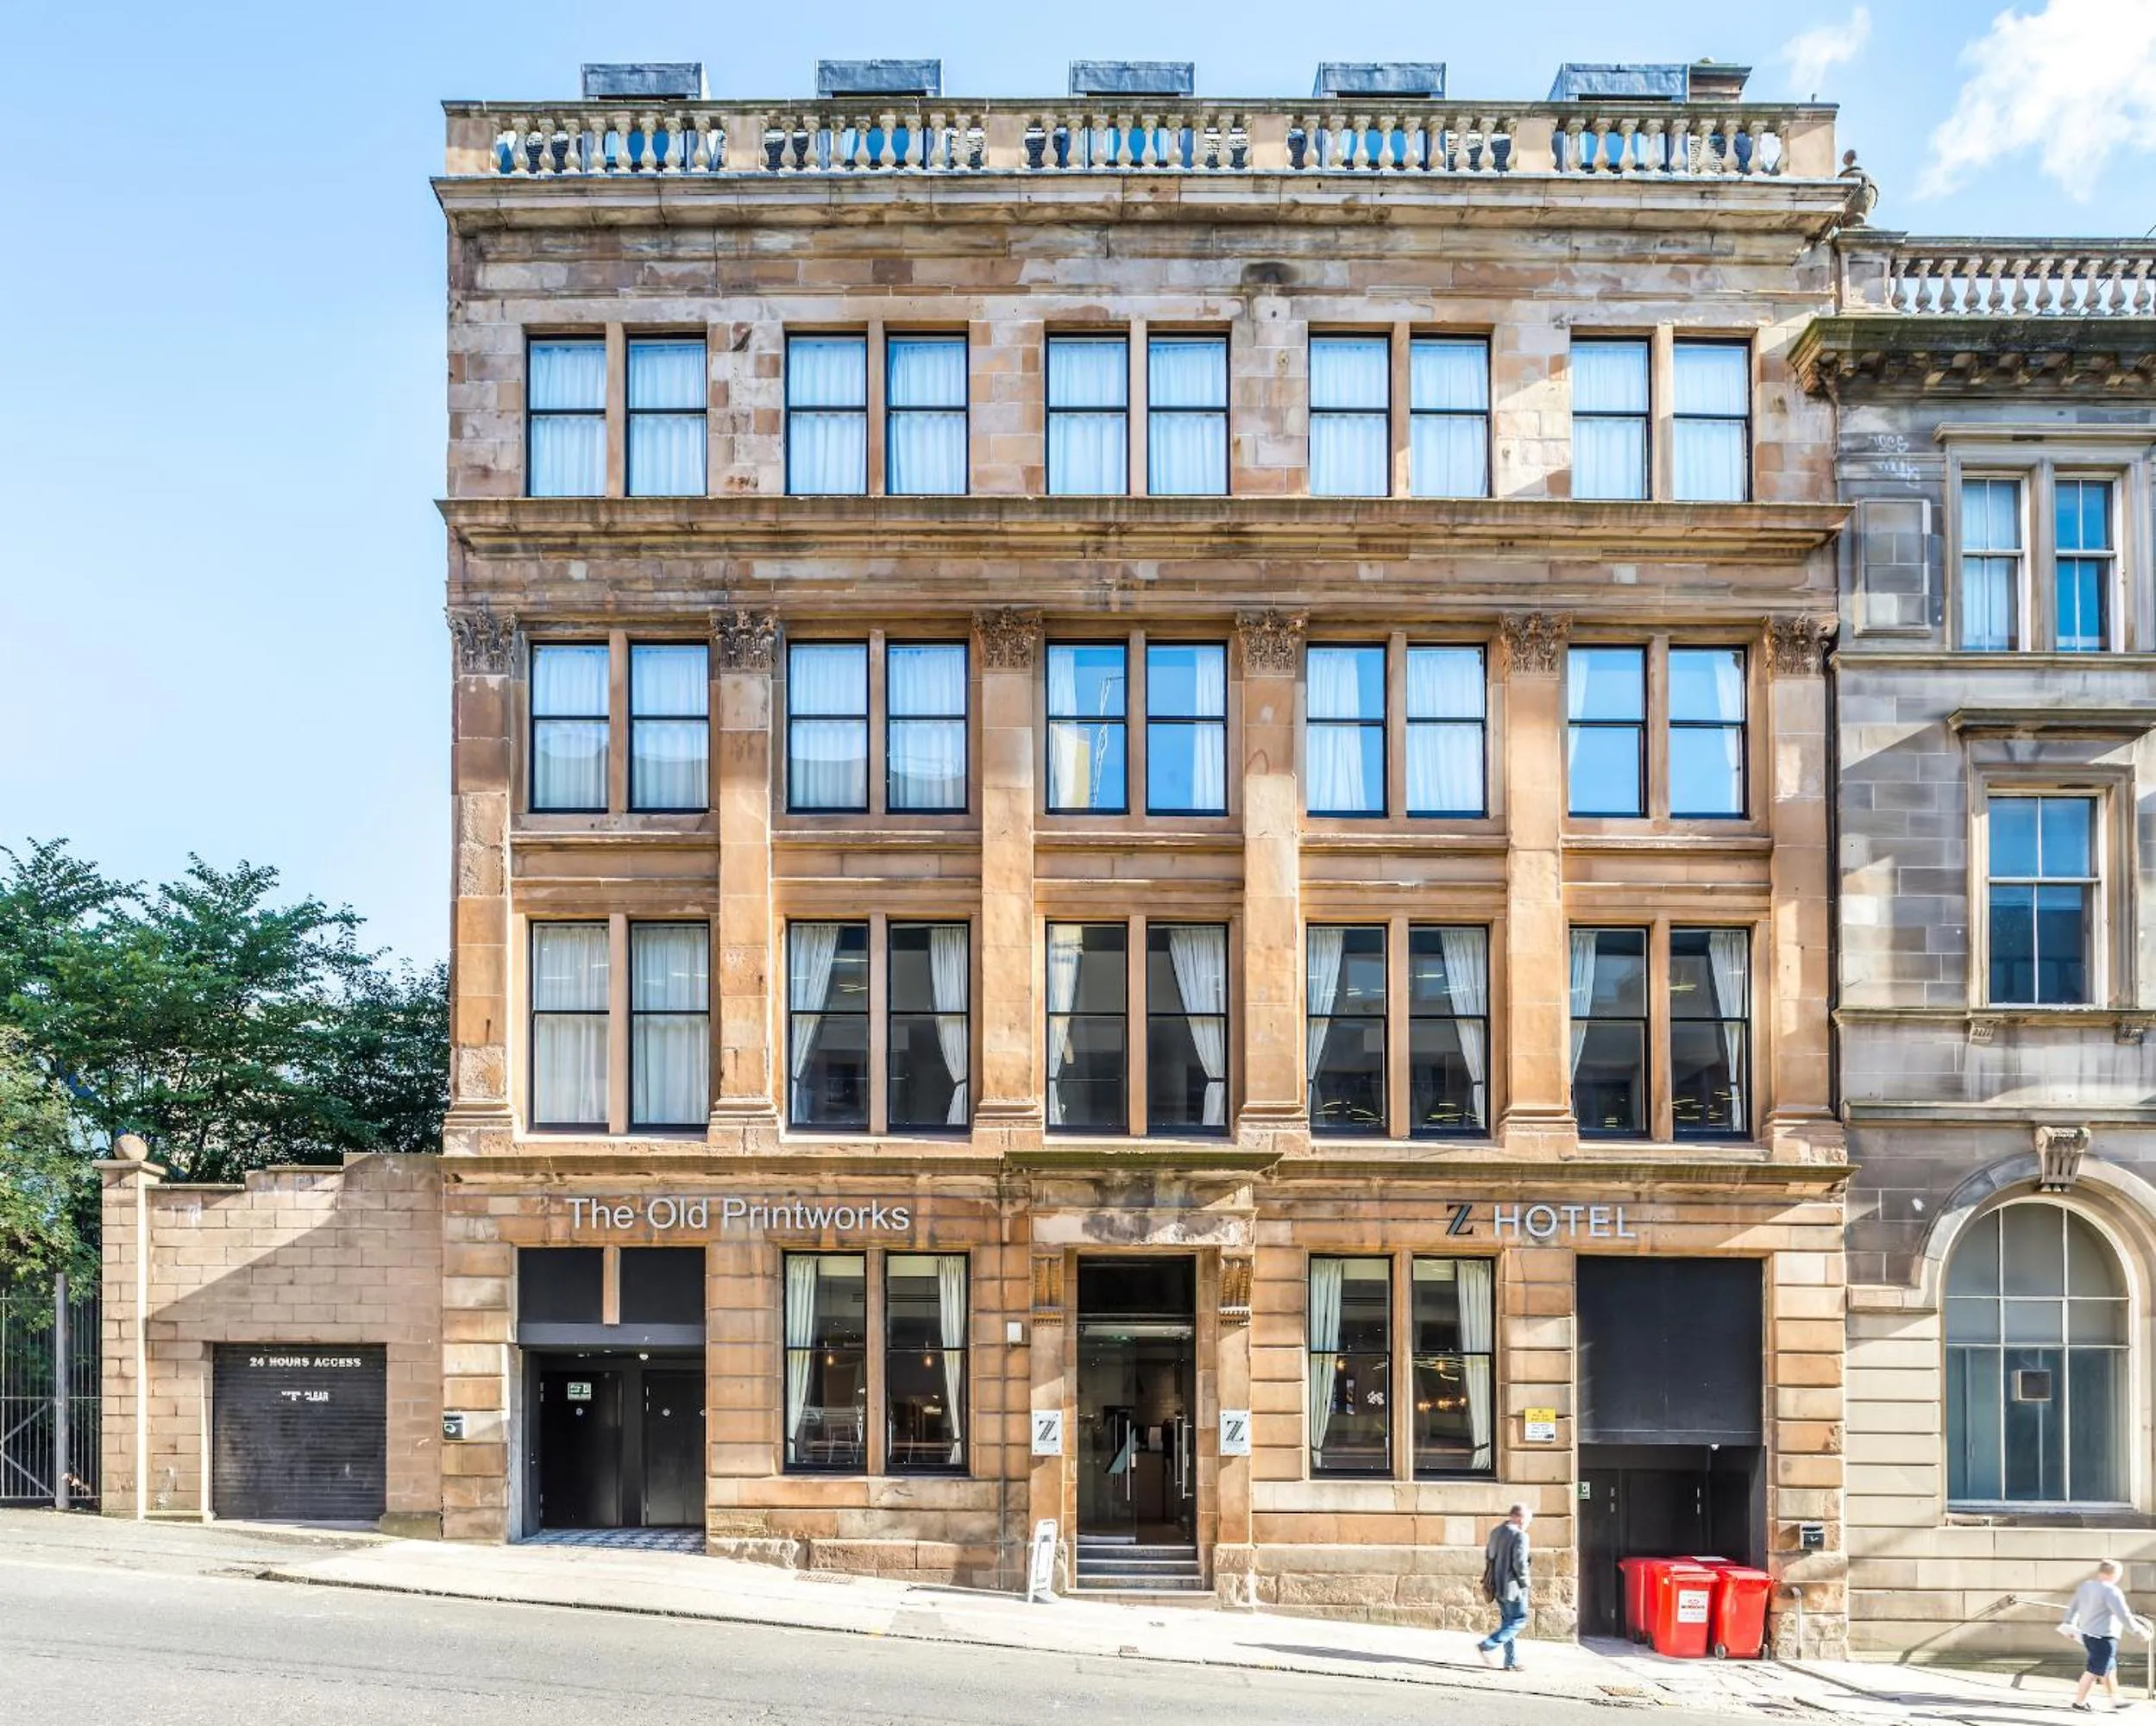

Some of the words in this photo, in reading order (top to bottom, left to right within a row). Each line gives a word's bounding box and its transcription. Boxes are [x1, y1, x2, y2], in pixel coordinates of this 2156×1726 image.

[563, 1196, 635, 1230] The
[647, 1196, 707, 1230] Old
[722, 1196, 910, 1232] Printworks
[1445, 1203, 1474, 1236] Z
[1493, 1204, 1637, 1238] HOTEL
[249, 1356, 265, 1367] 24
[269, 1356, 310, 1367] HOURS
[313, 1356, 361, 1367] ACCESS
[1038, 1421, 1057, 1441] Z
[1225, 1421, 1244, 1441] Z
